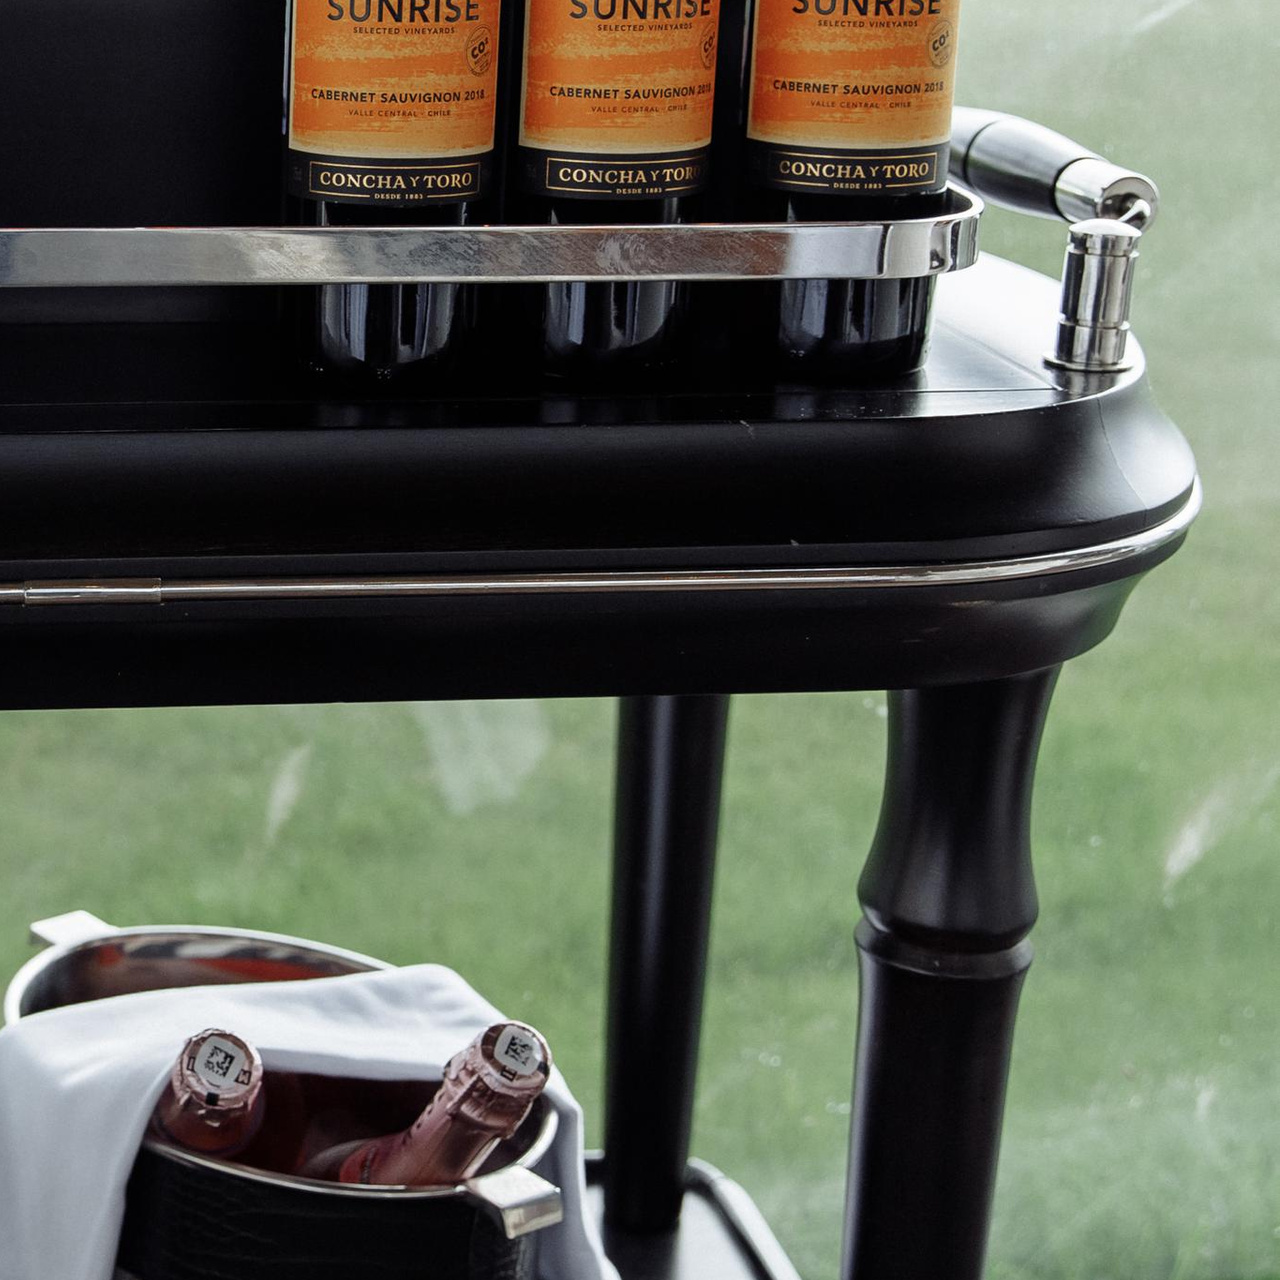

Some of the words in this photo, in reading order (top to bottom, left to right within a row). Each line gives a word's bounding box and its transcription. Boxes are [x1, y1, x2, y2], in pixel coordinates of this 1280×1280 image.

[353, 26, 400, 35] SELECTED
[405, 27, 455, 35] VINEYARDS
[598, 24, 644, 32] SELECTED
[648, 23, 693, 31] VINEYARDS
[818, 20, 865, 28] SELECTED
[870, 20, 918, 28] VINEYARDS
[549, 86, 619, 100] CABERNET
[624, 86, 695, 99] SAUVIGNON
[773, 80, 838, 95] CABERNET
[843, 83, 920, 95] SAUVIGNON
[924, 81, 943, 93] 2018
[311, 88, 376, 102] CABERNET
[381, 91, 460, 103] SAUVIGNON
[465, 89, 484, 101] 2018
[559, 168, 647, 183] CONCHA
[650, 170, 660, 182] Y
[779, 160, 870, 178] CONCHA
[870, 166, 879, 177] Y
[882, 162, 929, 178] TORO
[320, 171, 406, 189] CONCHA
[409, 176, 420, 188] Y
[424, 172, 472, 189] TORO
